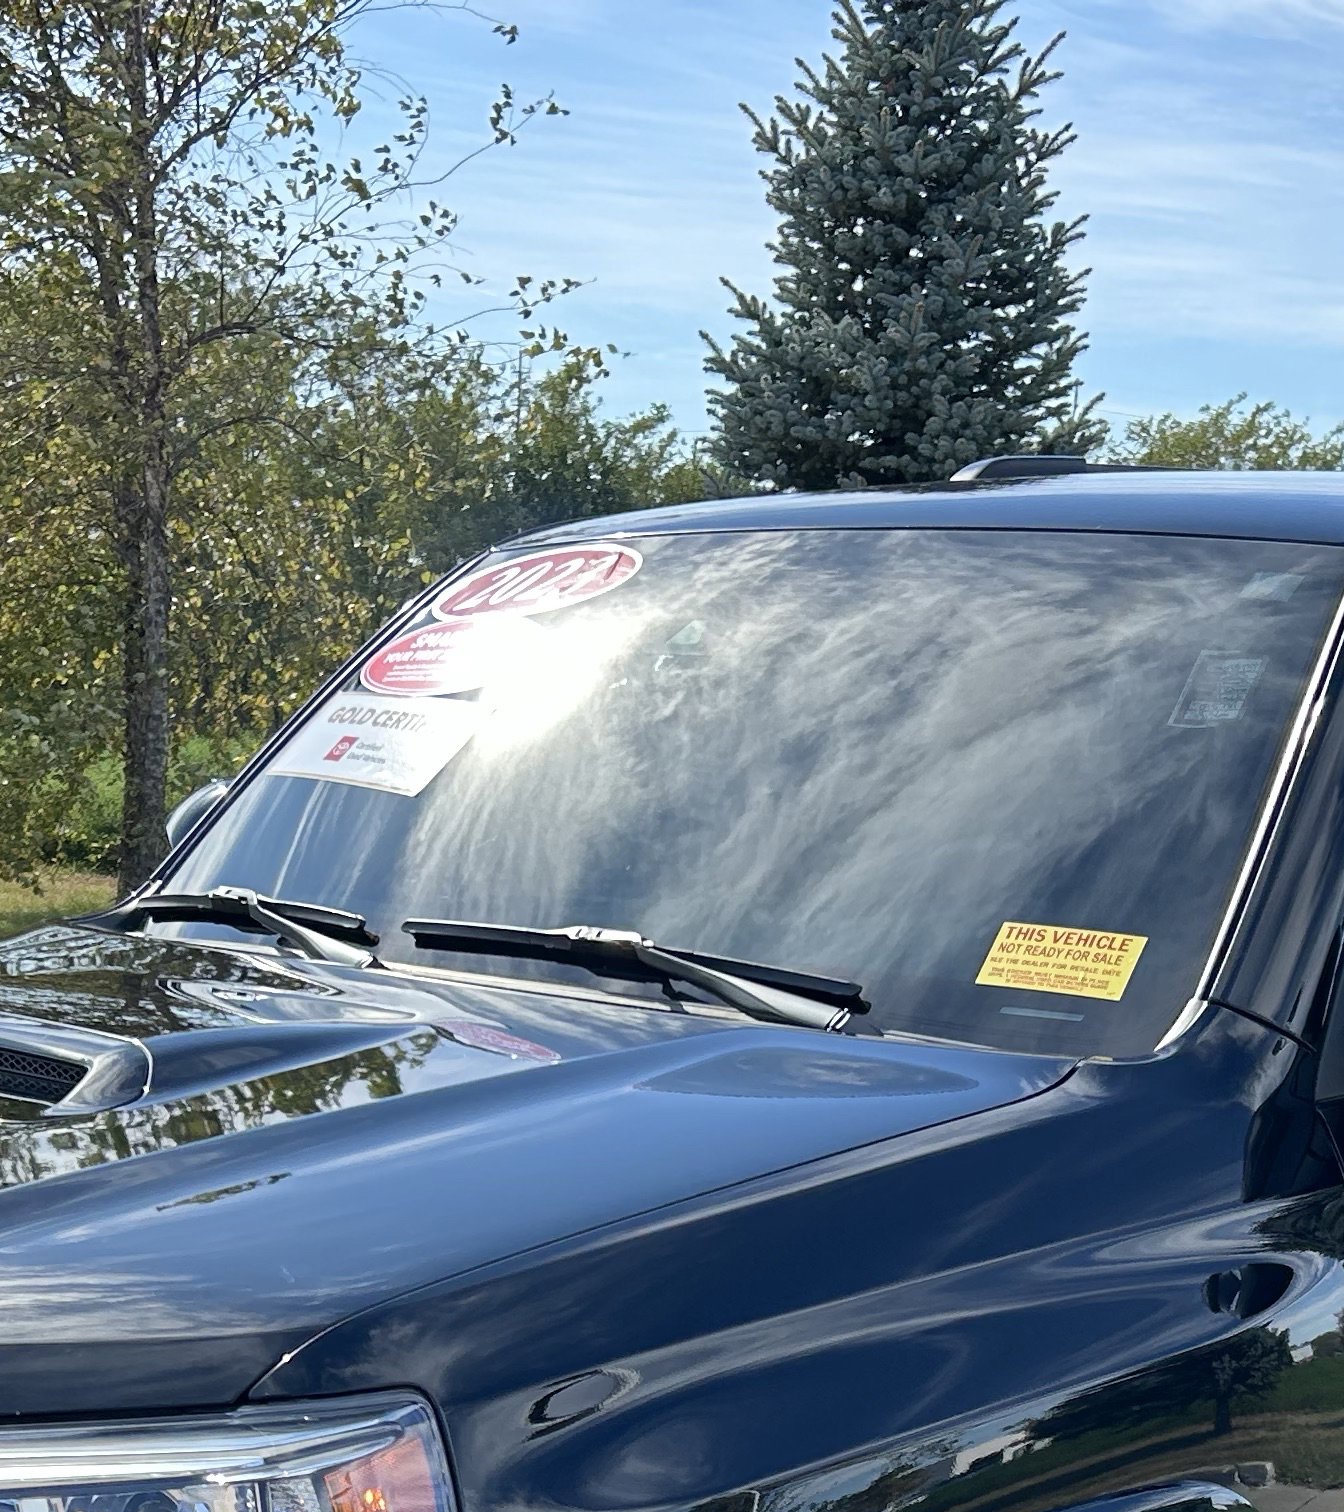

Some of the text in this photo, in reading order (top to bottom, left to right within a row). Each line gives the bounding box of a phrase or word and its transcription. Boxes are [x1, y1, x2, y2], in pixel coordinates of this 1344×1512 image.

[328, 706, 376, 725] GOLD
[1006, 926, 1133, 953] THIS VEHICLE
[997, 942, 1125, 967] NOT READY FOR SALE
[1021, 959, 1049, 968] DEALER
[1051, 962, 1068, 970] FOR
